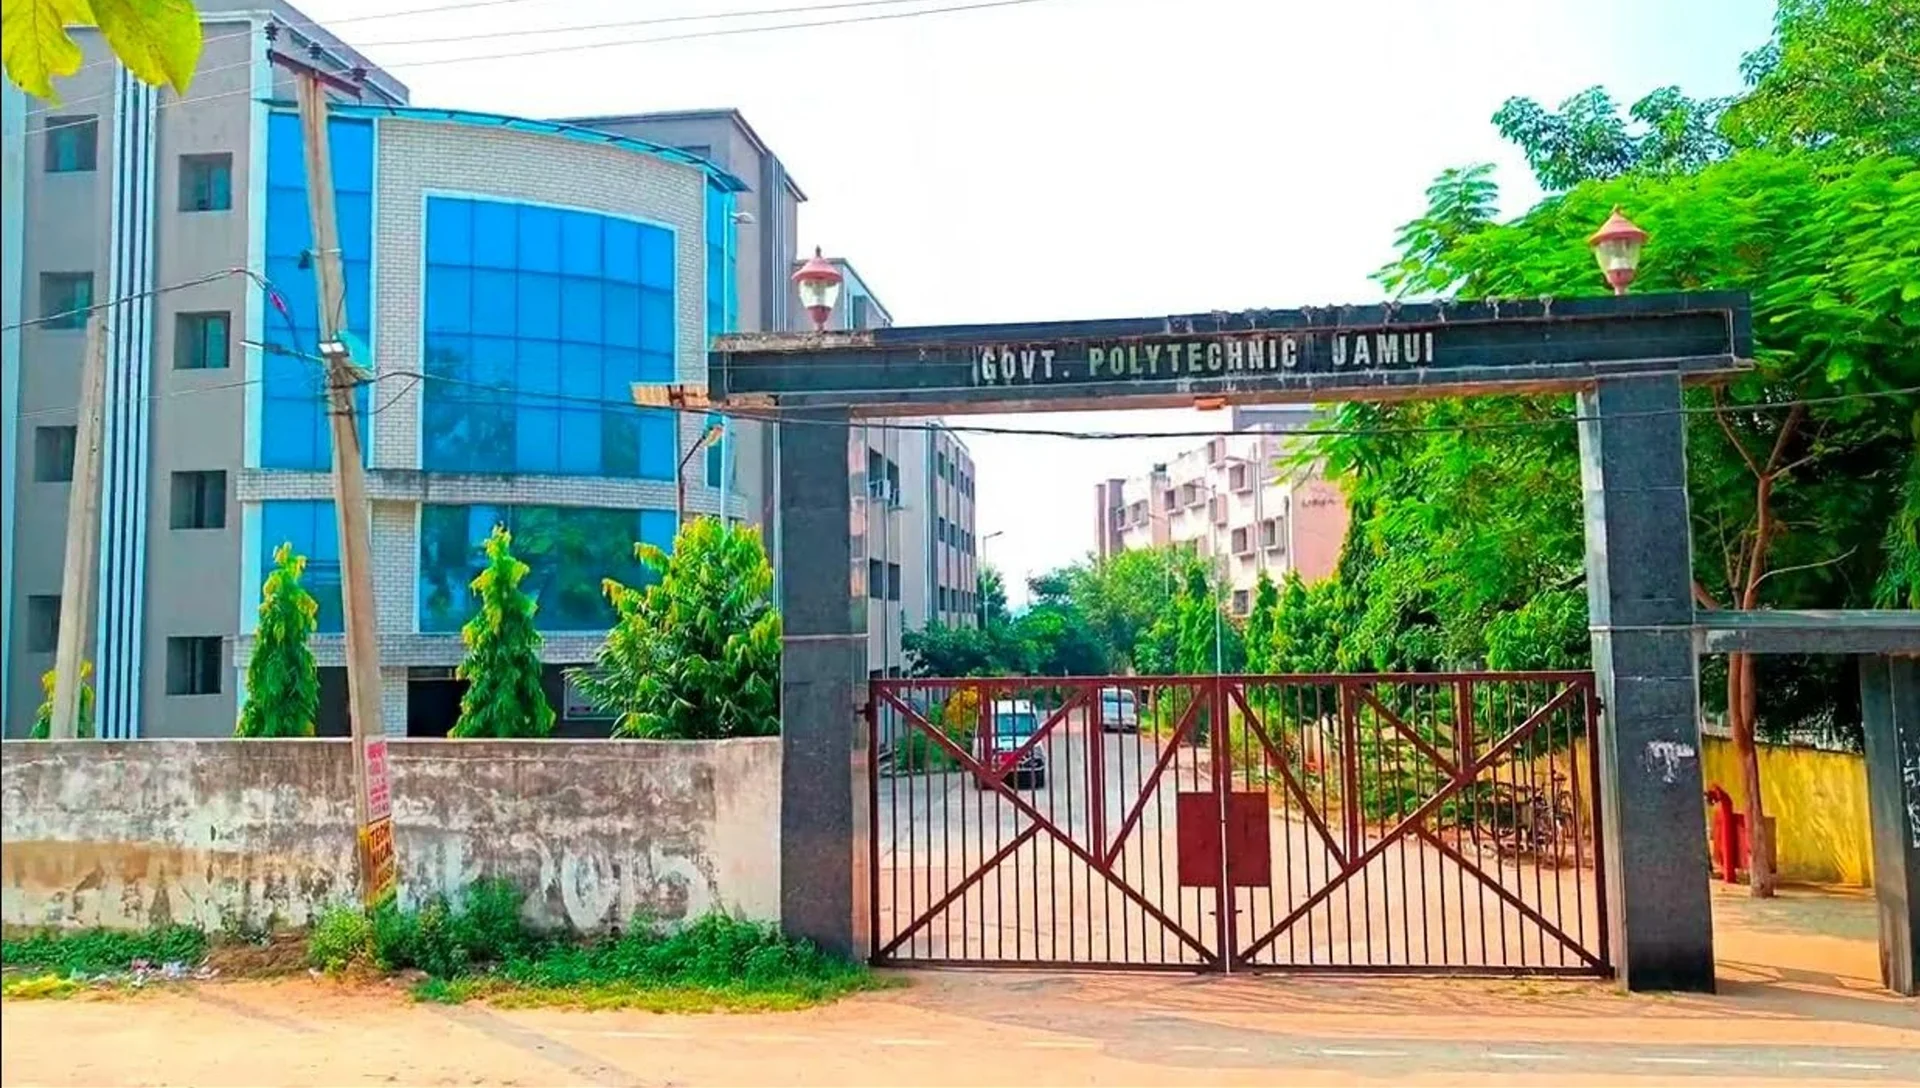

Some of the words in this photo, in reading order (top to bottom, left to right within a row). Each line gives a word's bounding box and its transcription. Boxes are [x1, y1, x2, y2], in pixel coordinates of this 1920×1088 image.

[981, 349, 1070, 381] GOVT.
[1089, 339, 1298, 376] POLYTECHNIC
[1333, 332, 1434, 365] JAMUI
